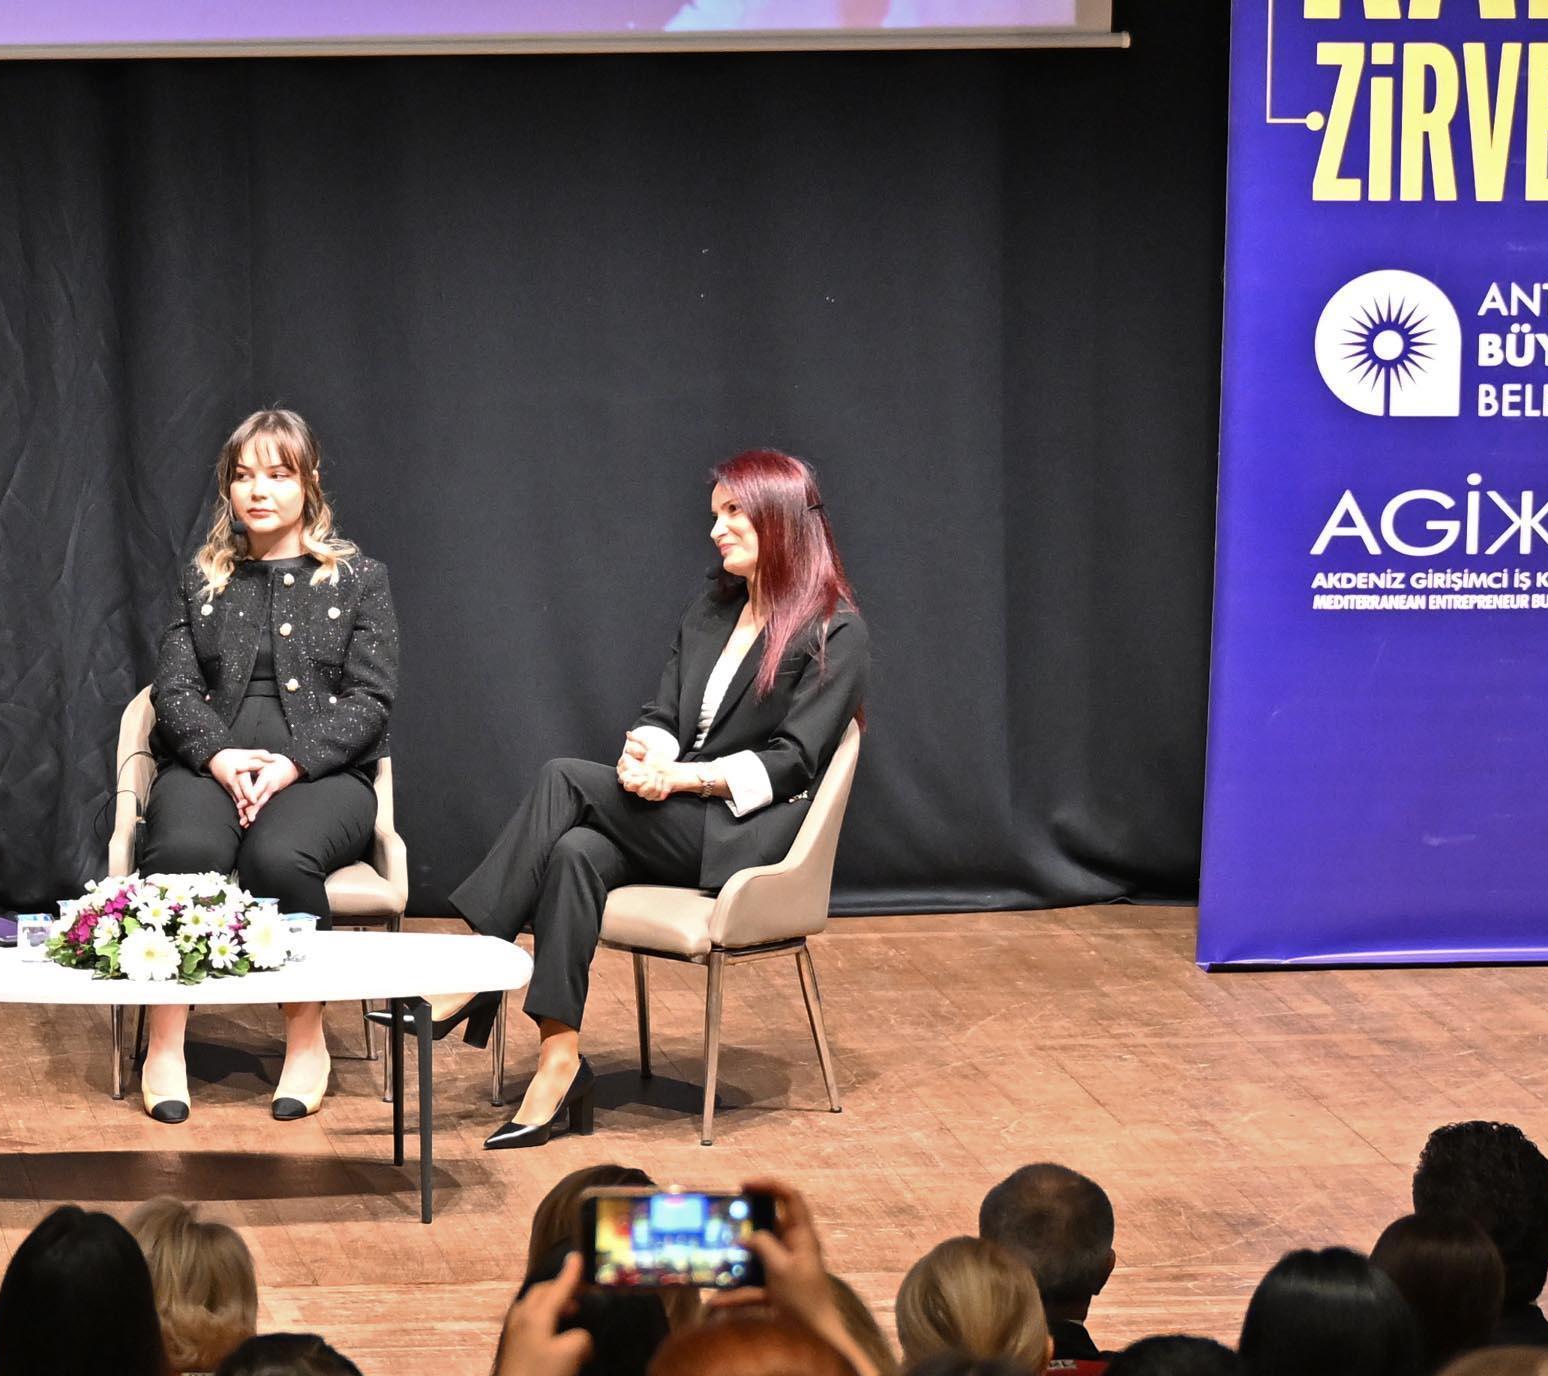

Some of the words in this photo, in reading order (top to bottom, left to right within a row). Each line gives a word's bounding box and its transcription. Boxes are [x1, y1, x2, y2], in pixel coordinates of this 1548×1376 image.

[1311, 568, 1405, 590] AKDENİZ
[1410, 568, 1508, 591] GİRİŞİMCİ
[1513, 568, 1532, 591] İŞ
[1313, 594, 1426, 610] MEDITERRANEAN
[1429, 594, 1529, 609] ENTREPRENEUR
